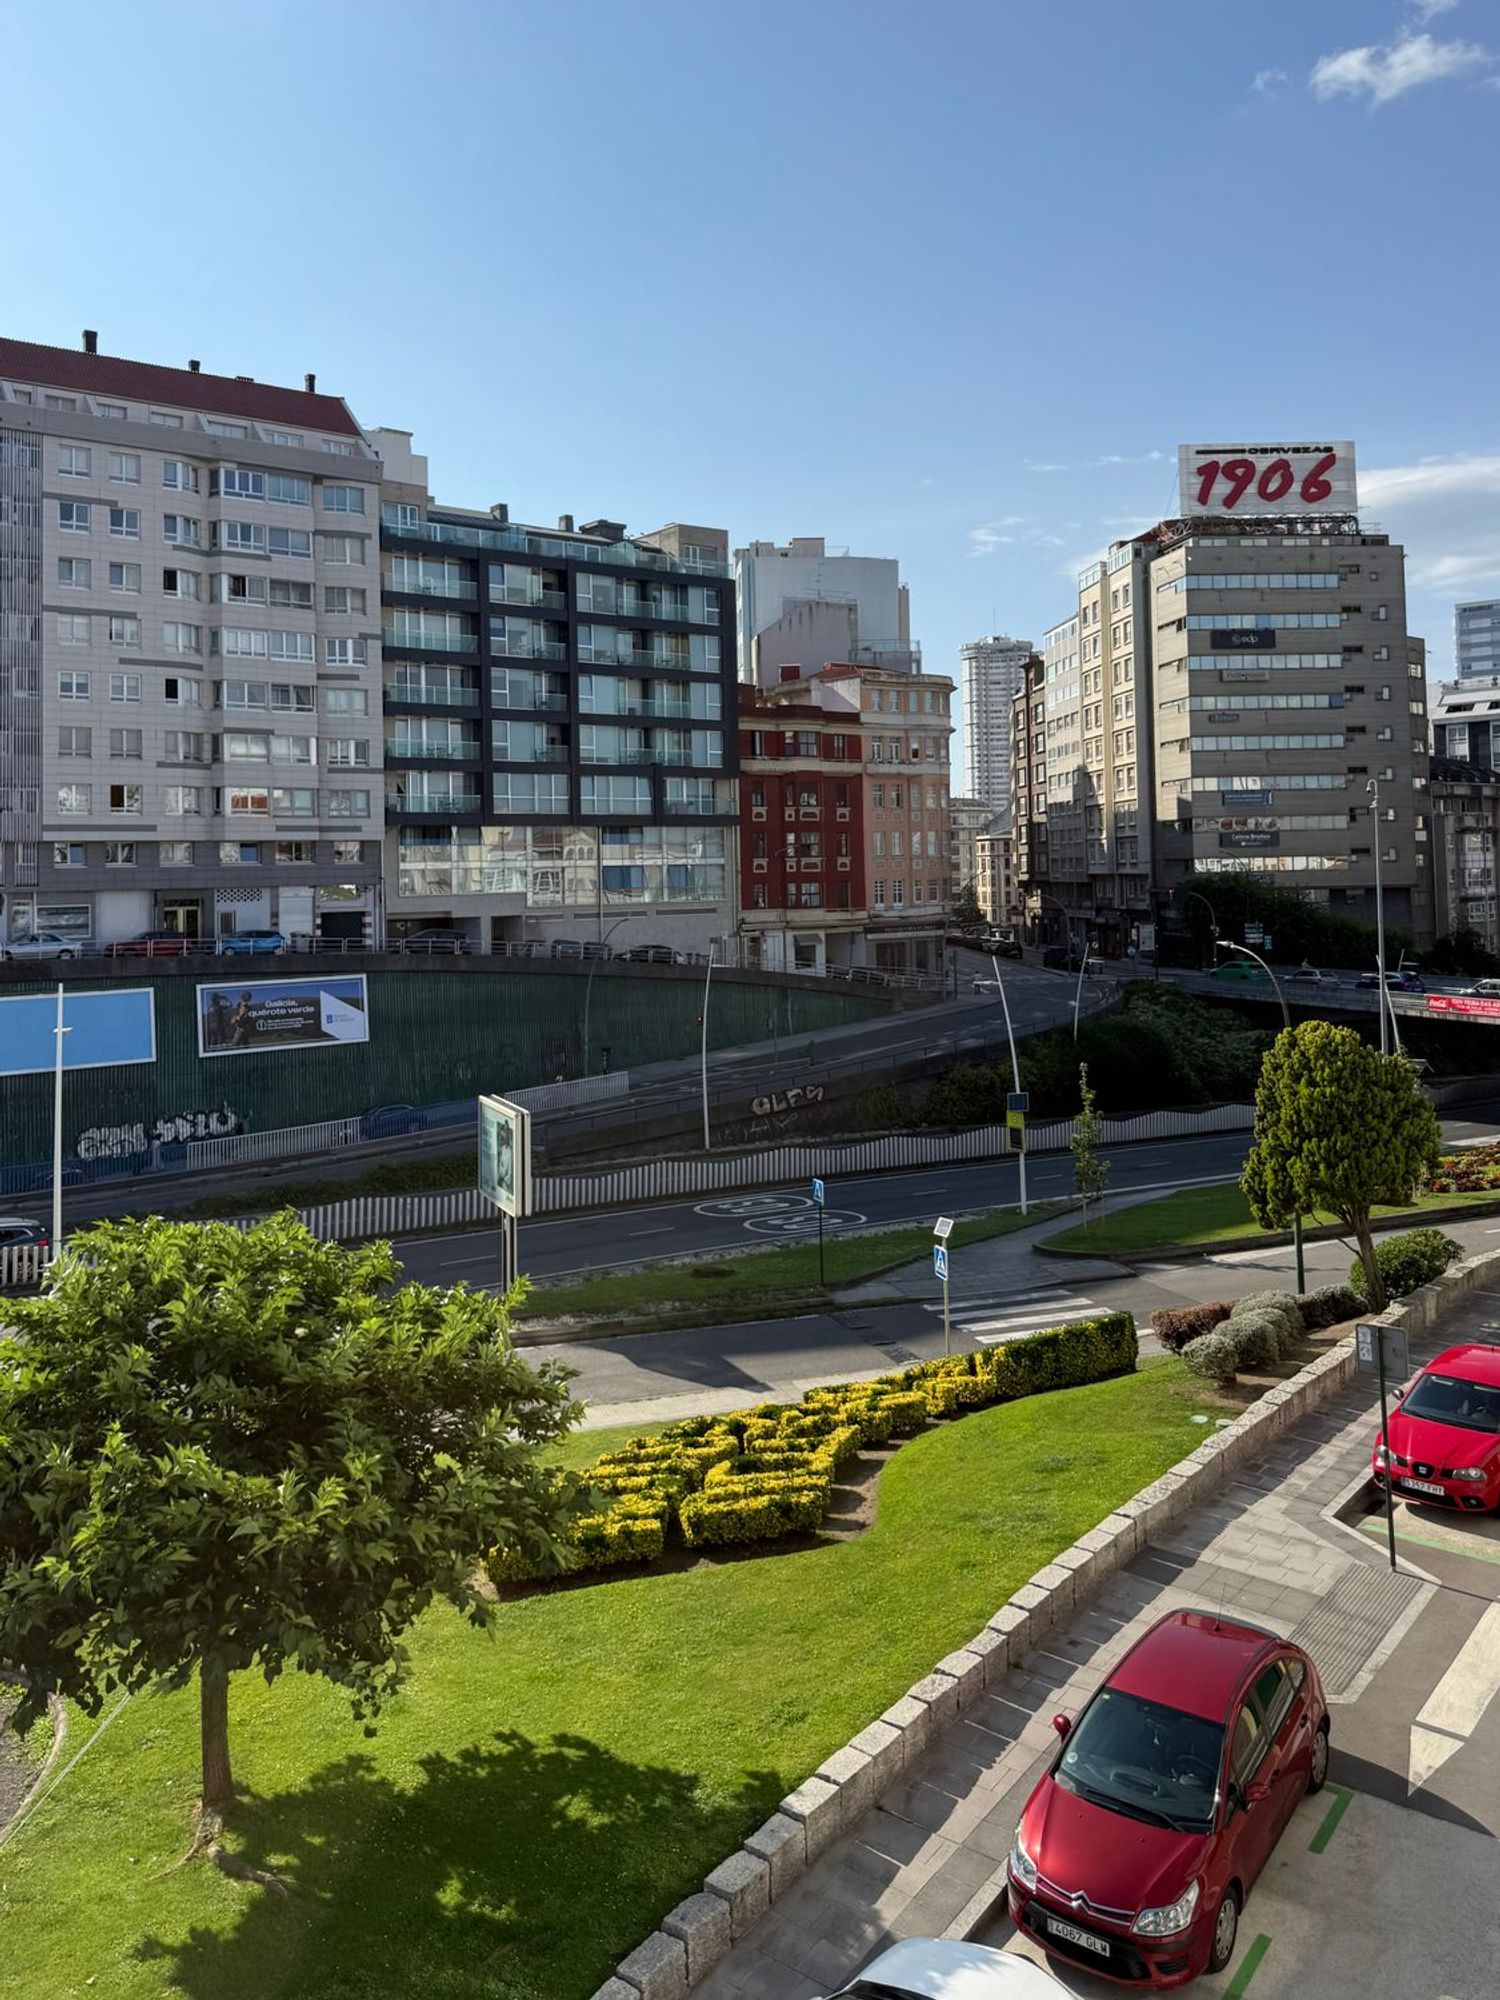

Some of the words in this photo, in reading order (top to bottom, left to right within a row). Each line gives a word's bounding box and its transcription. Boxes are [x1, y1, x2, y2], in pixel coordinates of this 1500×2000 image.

[1247, 446, 1334, 455] CERVEZAS
[1196, 453, 1337, 509] 1906
[1241, 633, 1259, 645] edp
[248, 1007, 287, 1017] quérote
[287, 1005, 315, 1014] verde
[1054, 1923, 1083, 1942] 4067
